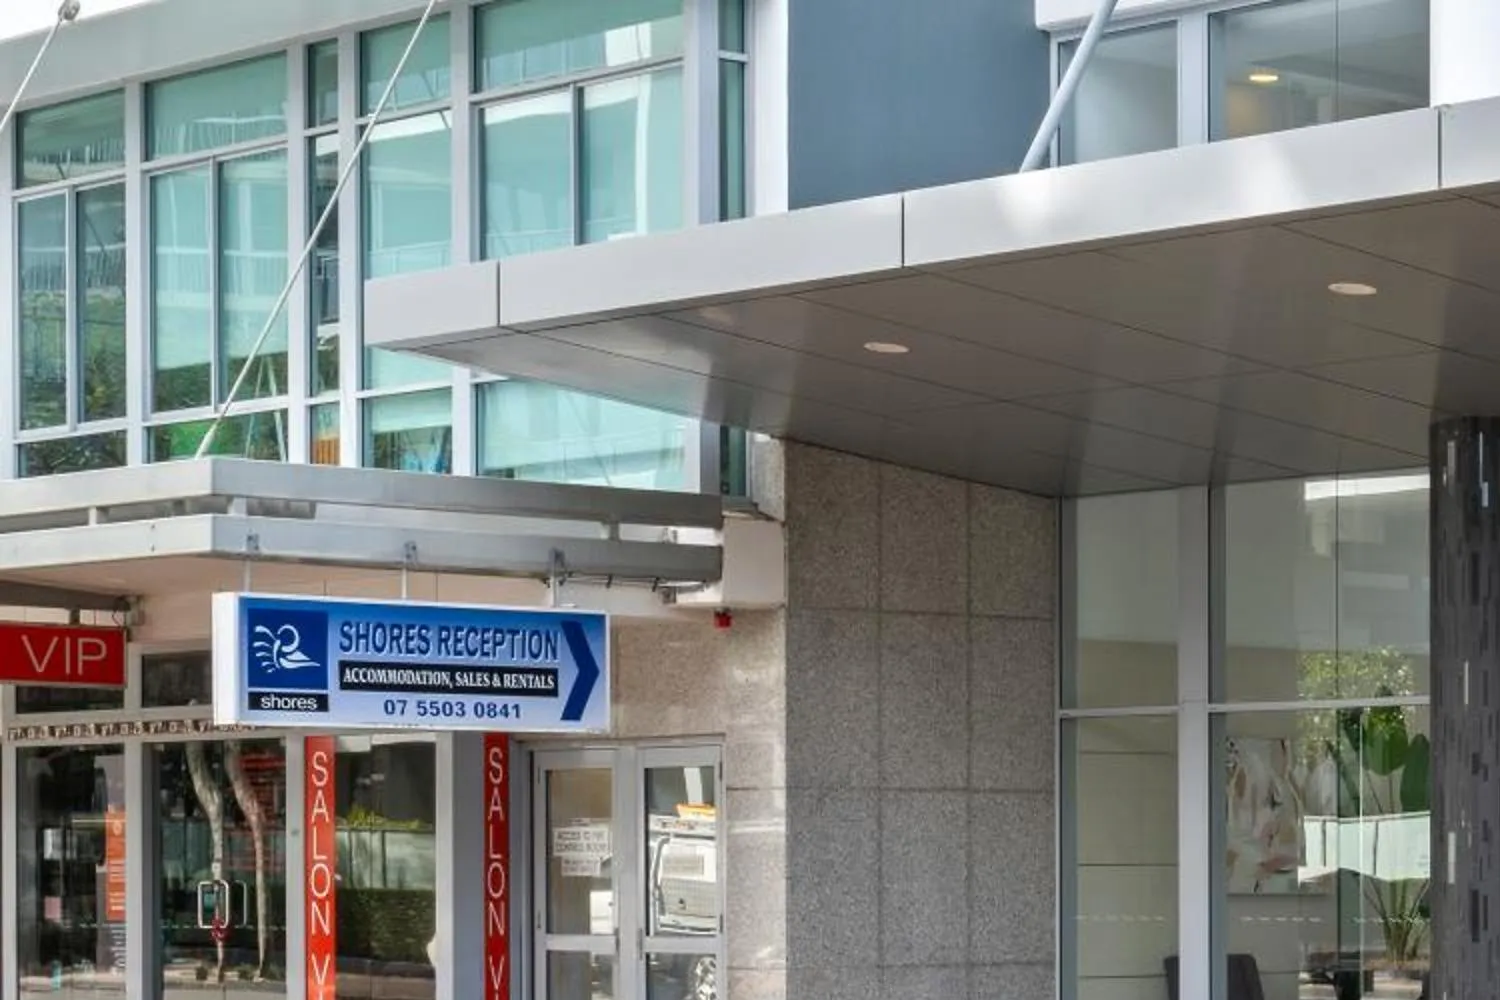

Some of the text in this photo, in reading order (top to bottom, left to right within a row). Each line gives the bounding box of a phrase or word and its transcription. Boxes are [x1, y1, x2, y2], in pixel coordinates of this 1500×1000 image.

[21, 634, 107, 676] VIP
[340, 620, 558, 661] SHORES RECEPTION
[343, 667, 555, 689] ACCOMMODATION, SALES & RENTALS
[261, 693, 318, 710] shores
[383, 699, 520, 719] 07 5503 0841
[310, 751, 331, 936] SALON
[487, 747, 506, 936] SALON
